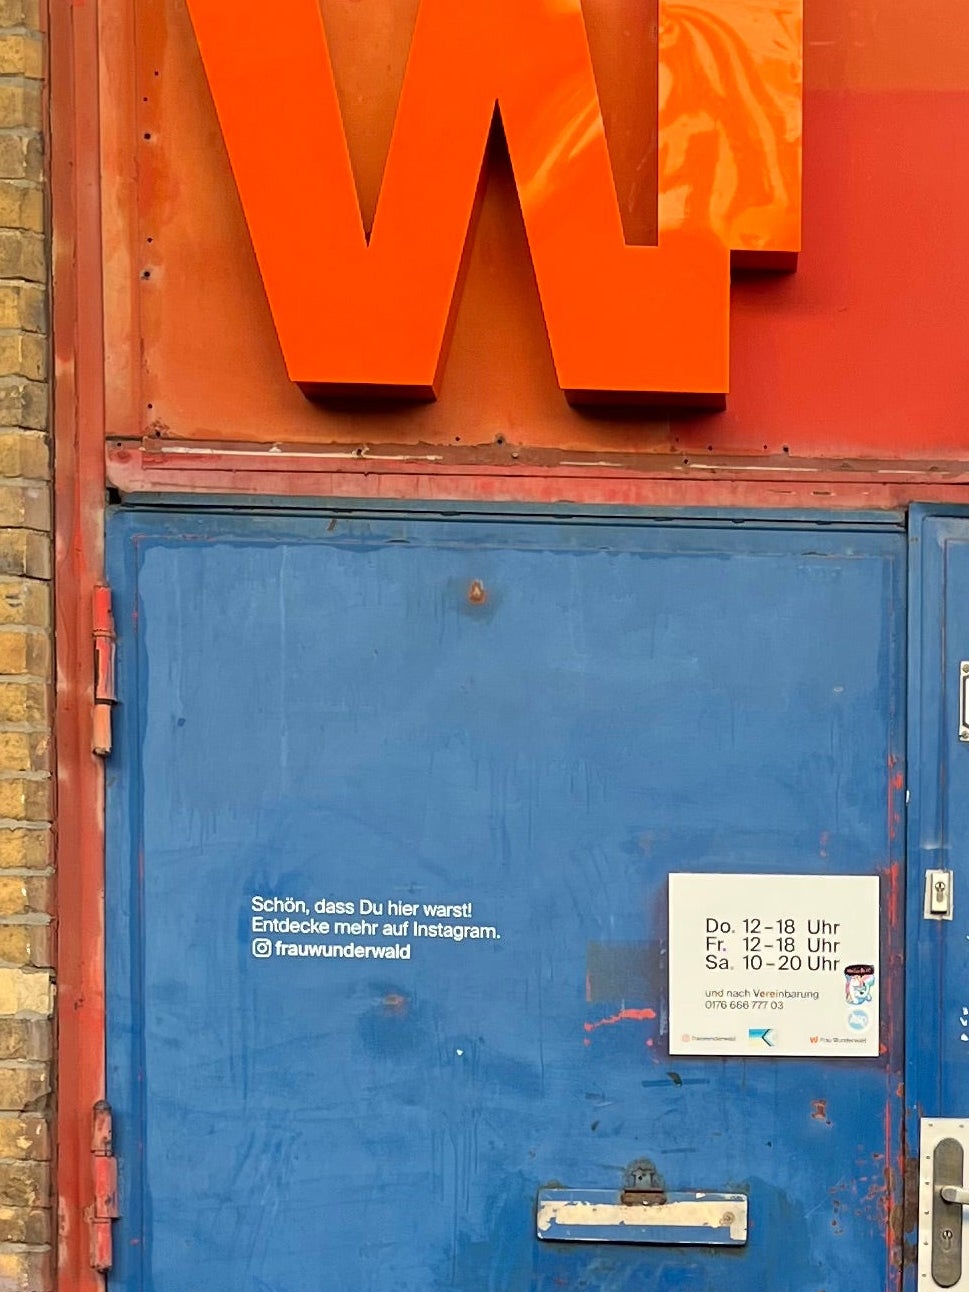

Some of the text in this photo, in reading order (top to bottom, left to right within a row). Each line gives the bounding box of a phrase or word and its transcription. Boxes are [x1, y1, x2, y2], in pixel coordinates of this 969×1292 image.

[251, 896, 472, 918] Schön, dass Du hier warst!
[252, 917, 501, 942] Entdecke mehr auf Instagram.
[705, 918, 736, 934] Do.
[807, 919, 840, 935] Uhr
[275, 941, 411, 960] frauwunderwald
[705, 936, 728, 952] Fr.
[807, 938, 840, 953] Uhr
[705, 955, 735, 970] Sa.
[807, 956, 840, 971] Uhr
[705, 989, 820, 1000] und nach Vereinbarung
[705, 1000, 728, 1010] 0176
[751, 1001, 769, 1010] 777
